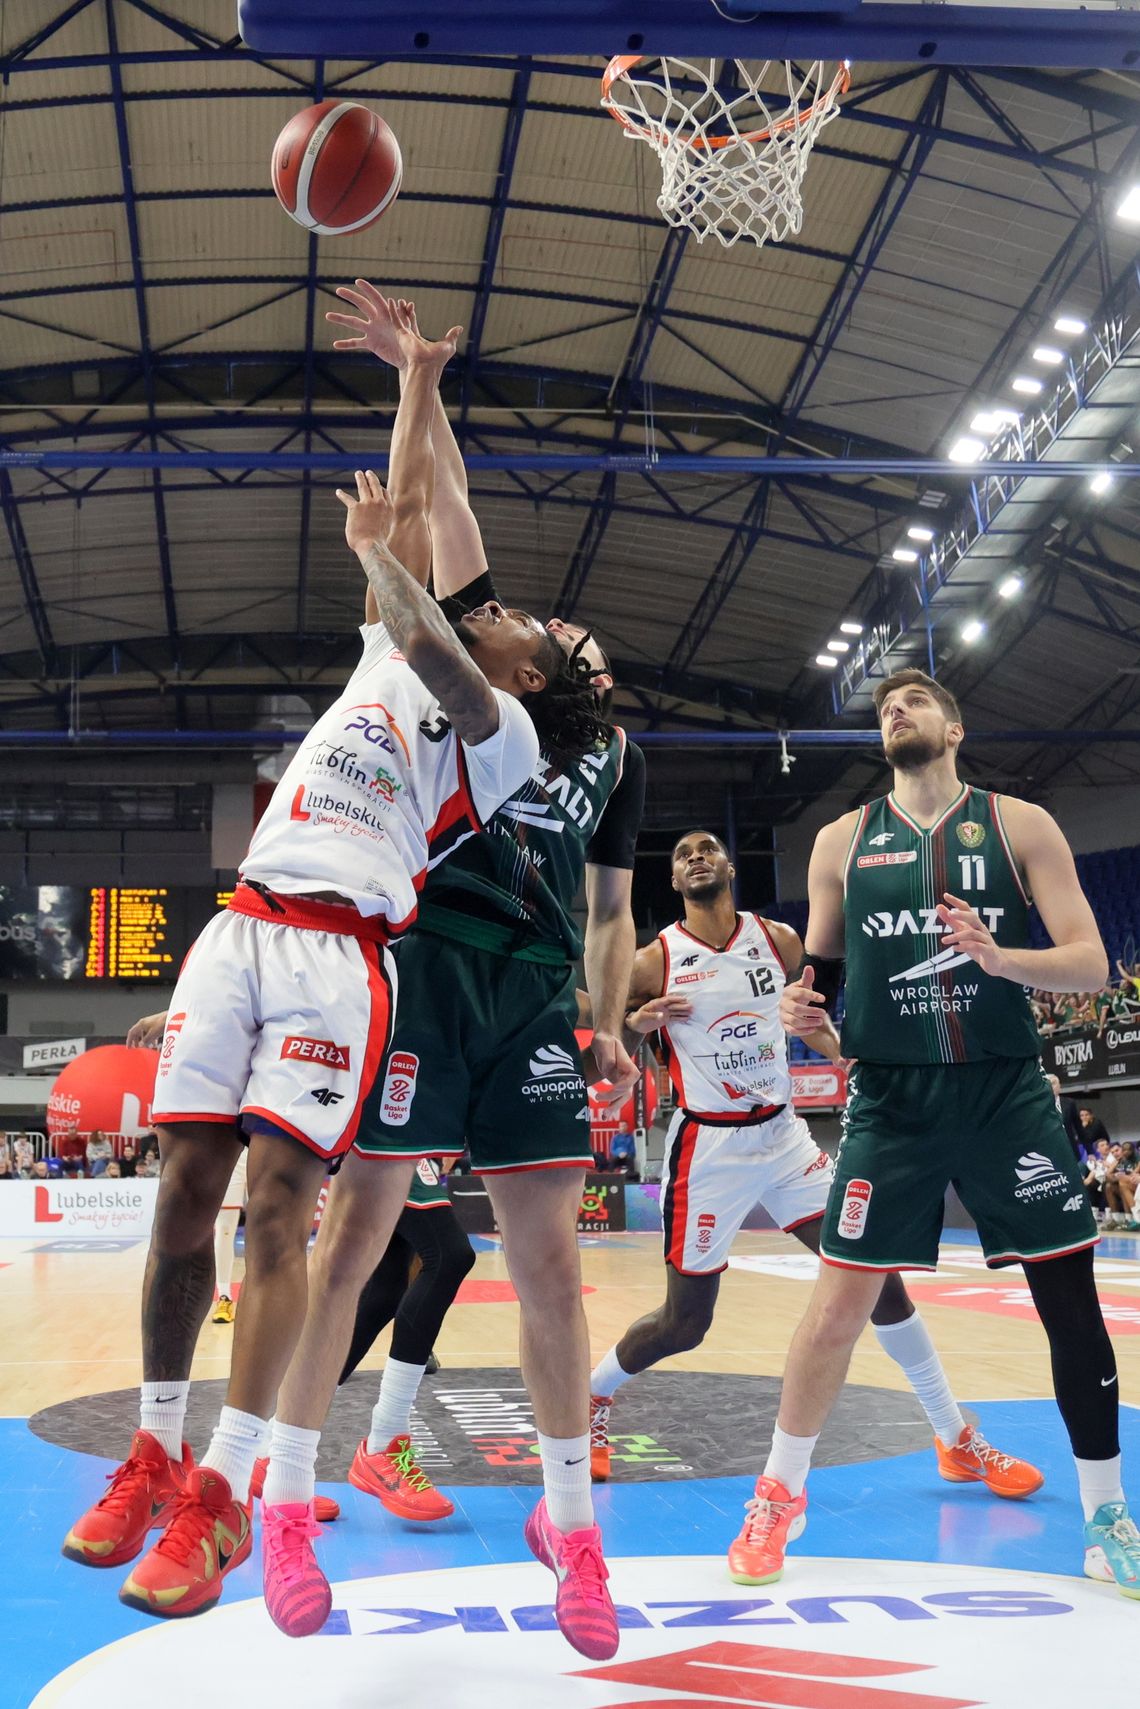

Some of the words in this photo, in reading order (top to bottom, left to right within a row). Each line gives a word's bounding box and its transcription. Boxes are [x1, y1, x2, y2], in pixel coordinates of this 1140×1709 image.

[860, 856, 885, 865] ORLEN
[958, 855, 986, 890] 11
[862, 908, 1004, 938] BAZT
[681, 954, 699, 966] 4F
[744, 967, 776, 997] 12
[890, 984, 979, 1001] WROCLAW
[900, 1000, 973, 1016] AIRPORT
[721, 1022, 757, 1041] PGE
[1119, 1030, 1140, 1044] LEXU
[31, 1045, 78, 1061] PERŁA
[286, 1039, 347, 1065] PERŁA
[1054, 1040, 1093, 1065] BYSTRA
[392, 1061, 416, 1071] ORLEN
[521, 1077, 586, 1096] aquapark
[311, 1088, 344, 1106] 4F
[384, 1104, 408, 1112] Basket
[1014, 1174, 1069, 1198] aquapark
[57, 1191, 142, 1208] lubelskie
[1062, 1194, 1083, 1211] 4F
[309, 1590, 1075, 1637] SUZUKI
